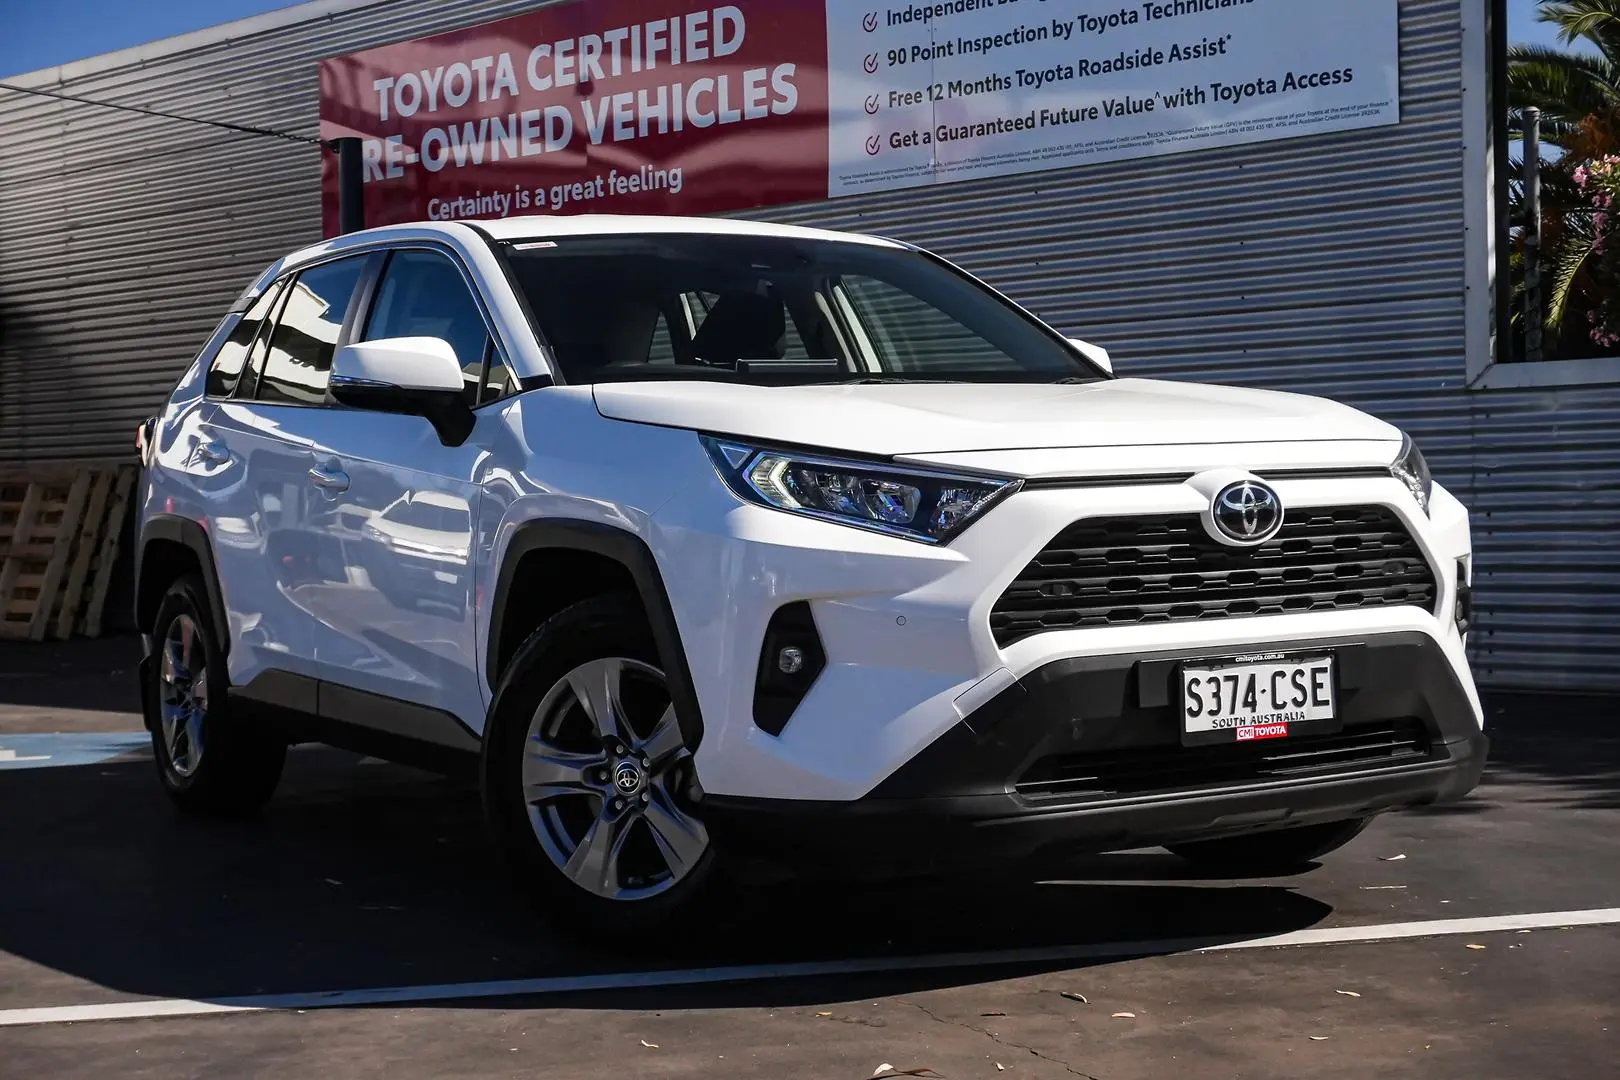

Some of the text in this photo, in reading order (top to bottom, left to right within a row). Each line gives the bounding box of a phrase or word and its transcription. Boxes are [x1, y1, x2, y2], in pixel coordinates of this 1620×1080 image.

[373, 6, 746, 120] TOYOTA CERTIFIED
[887, 0, 1254, 67] 90 Point Inspection by Toyota Technicia
[888, 90, 923, 108] Free
[926, 84, 944, 101] 12
[947, 74, 1012, 98] Months
[1015, 64, 1074, 89] Toyota
[1078, 47, 1165, 77] Roadside
[362, 63, 798, 183] RE-OWNED VEHICLES
[889, 131, 919, 149] Get
[922, 131, 932, 145] a
[935, 111, 1036, 142] Guaranteed
[1040, 106, 1099, 127] Future
[1162, 85, 1206, 108] with
[1209, 78, 1277, 104] Toyota
[1281, 68, 1353, 92] Access
[427, 166, 682, 221] Certainty is a great feeling
[1236, 653, 1285, 662] cmitoyota.com.au
[1212, 711, 1305, 728] SOUTH AUSTRALIA
[1238, 726, 1286, 738] CMI TOYOTA
